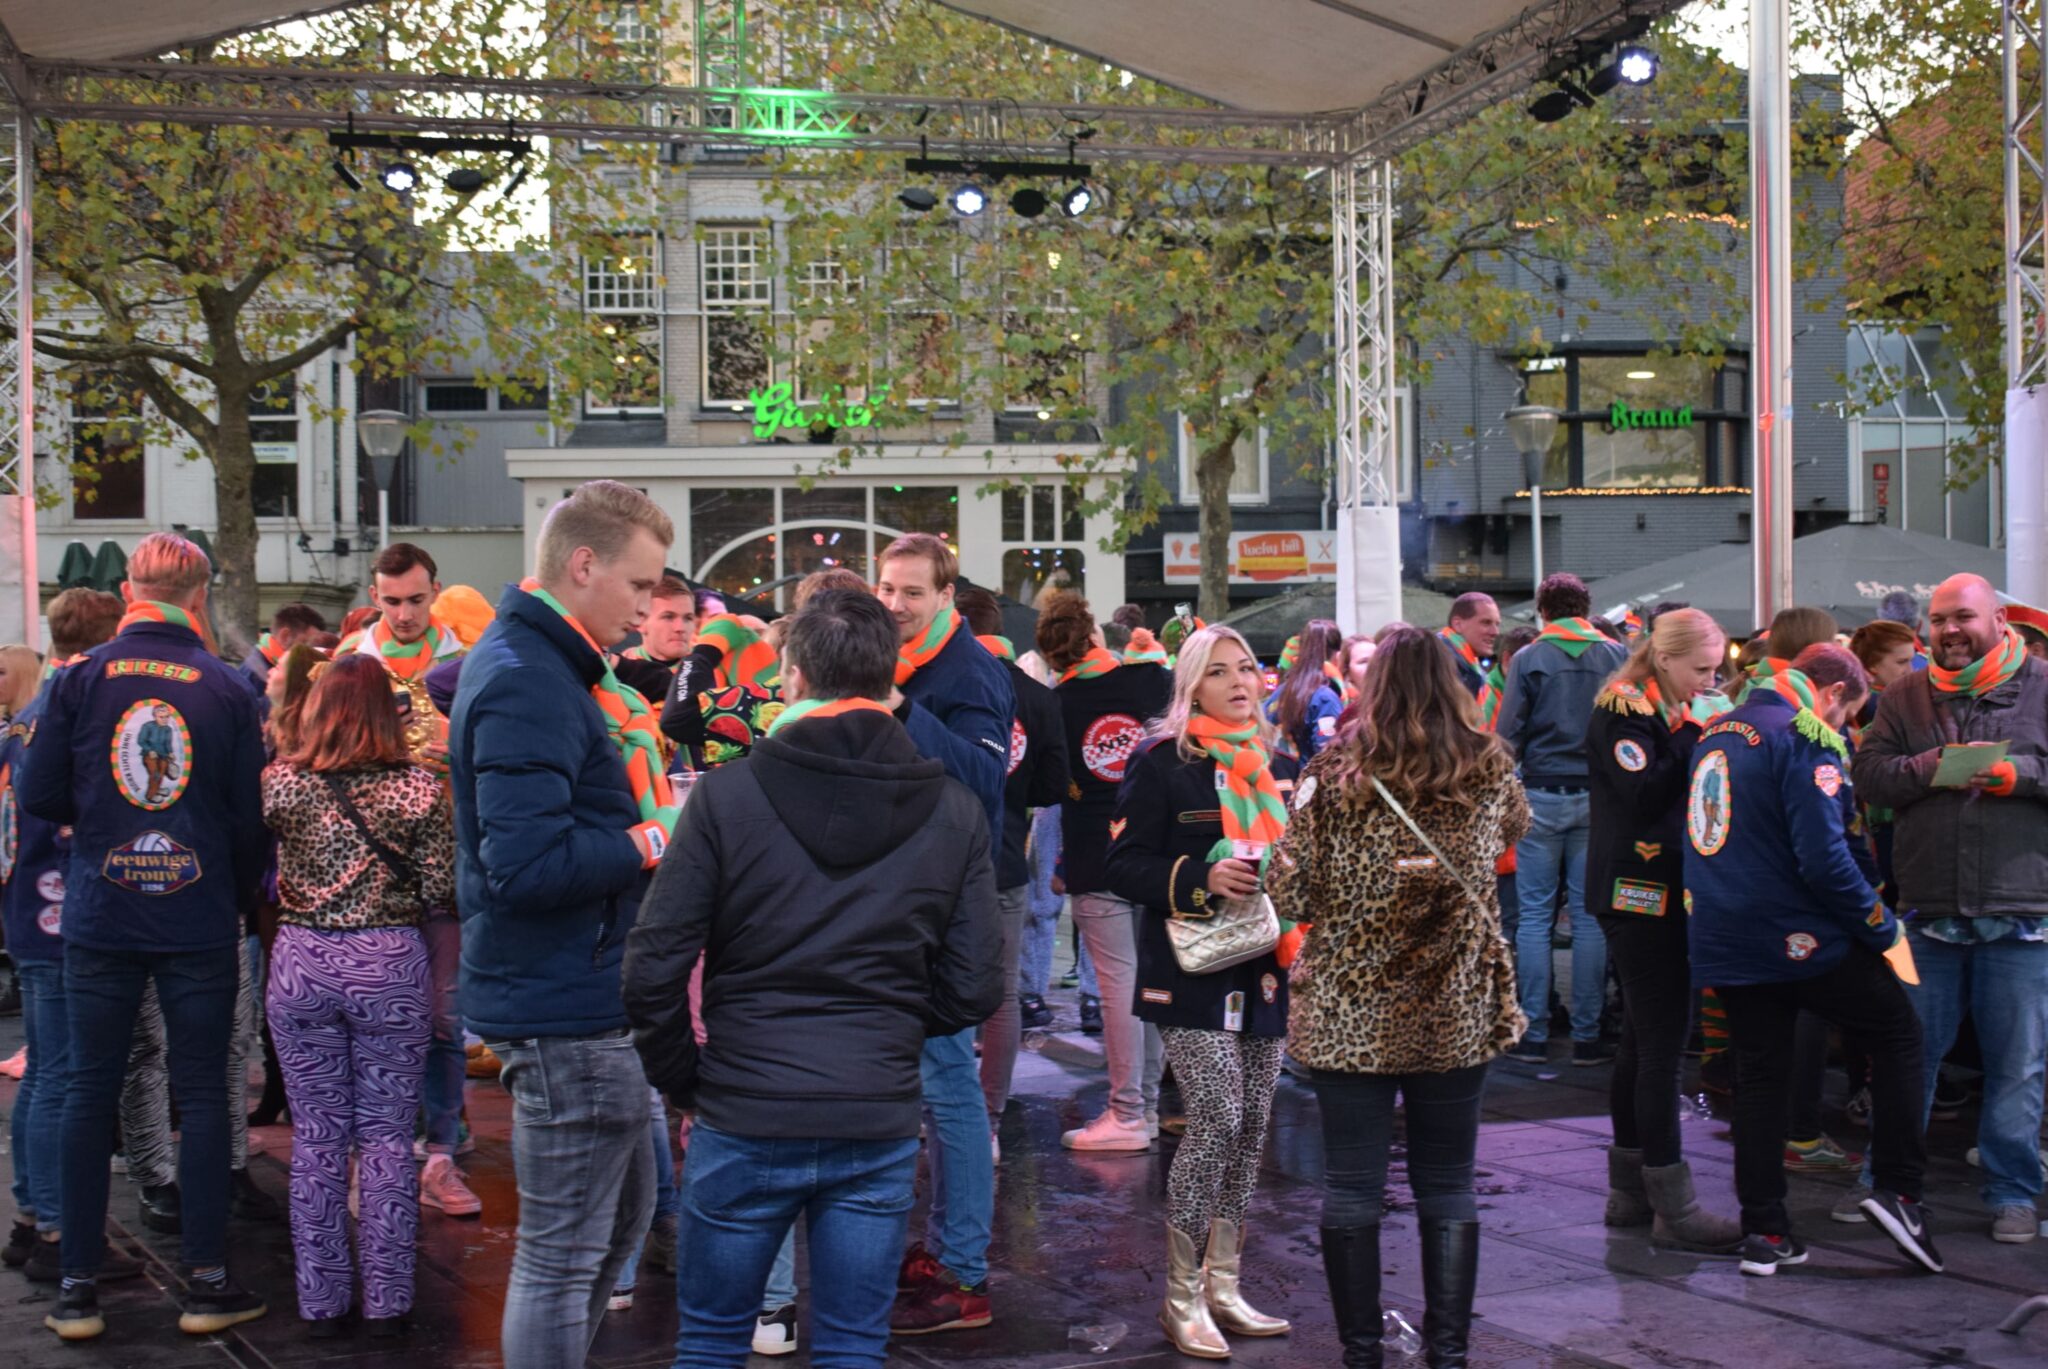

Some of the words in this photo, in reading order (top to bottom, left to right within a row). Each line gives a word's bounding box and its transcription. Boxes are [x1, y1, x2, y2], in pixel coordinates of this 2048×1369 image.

[1611, 399, 1693, 432] Brand
[1243, 543, 1279, 556] lucky
[1281, 539, 1300, 553] hill
[112, 851, 192, 871] eeuwige
[123, 867, 180, 882] trouw
[1620, 887, 1661, 902] KRUIKEN
